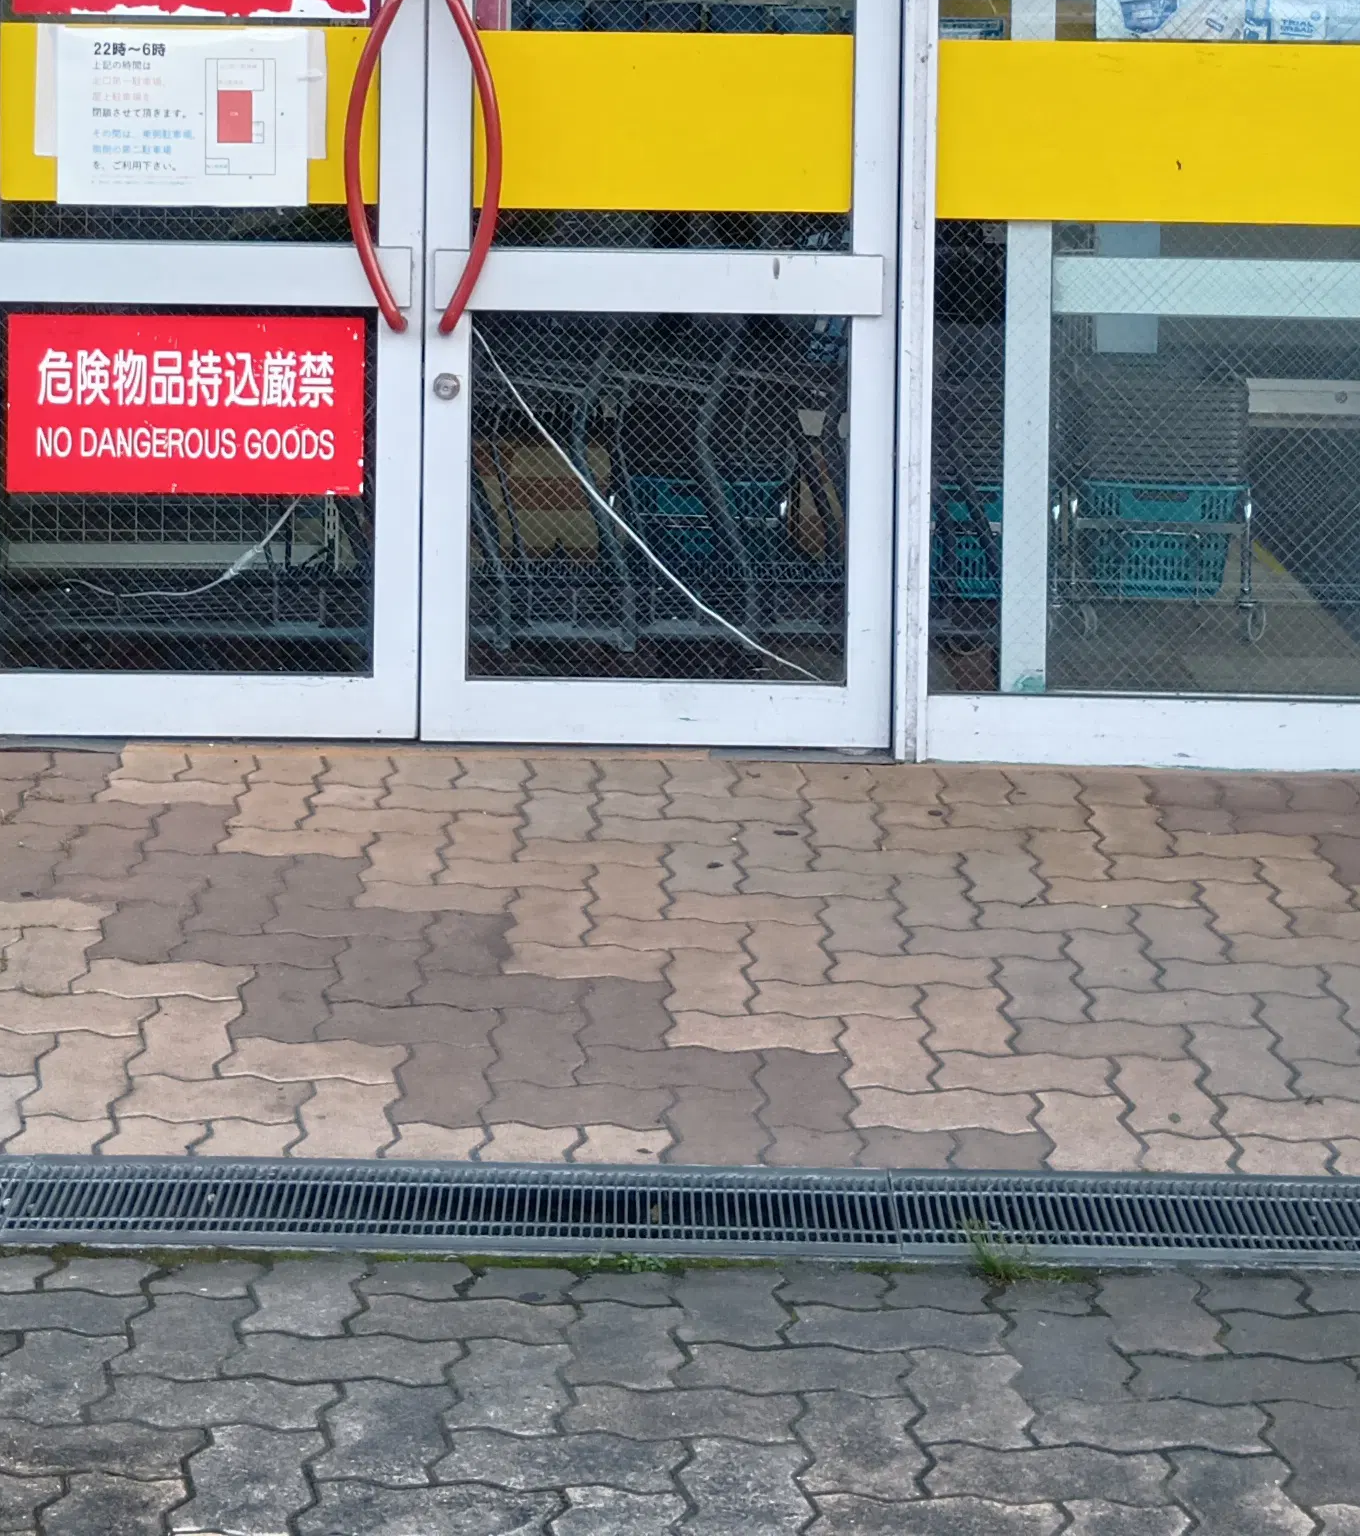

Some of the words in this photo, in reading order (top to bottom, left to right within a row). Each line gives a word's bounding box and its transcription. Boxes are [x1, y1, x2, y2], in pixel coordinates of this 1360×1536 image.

[37, 348, 335, 408] 危険物品持込厳禁
[36, 426, 72, 459] NO
[80, 427, 236, 460] DANGEROUS
[244, 428, 335, 461] GOODS
